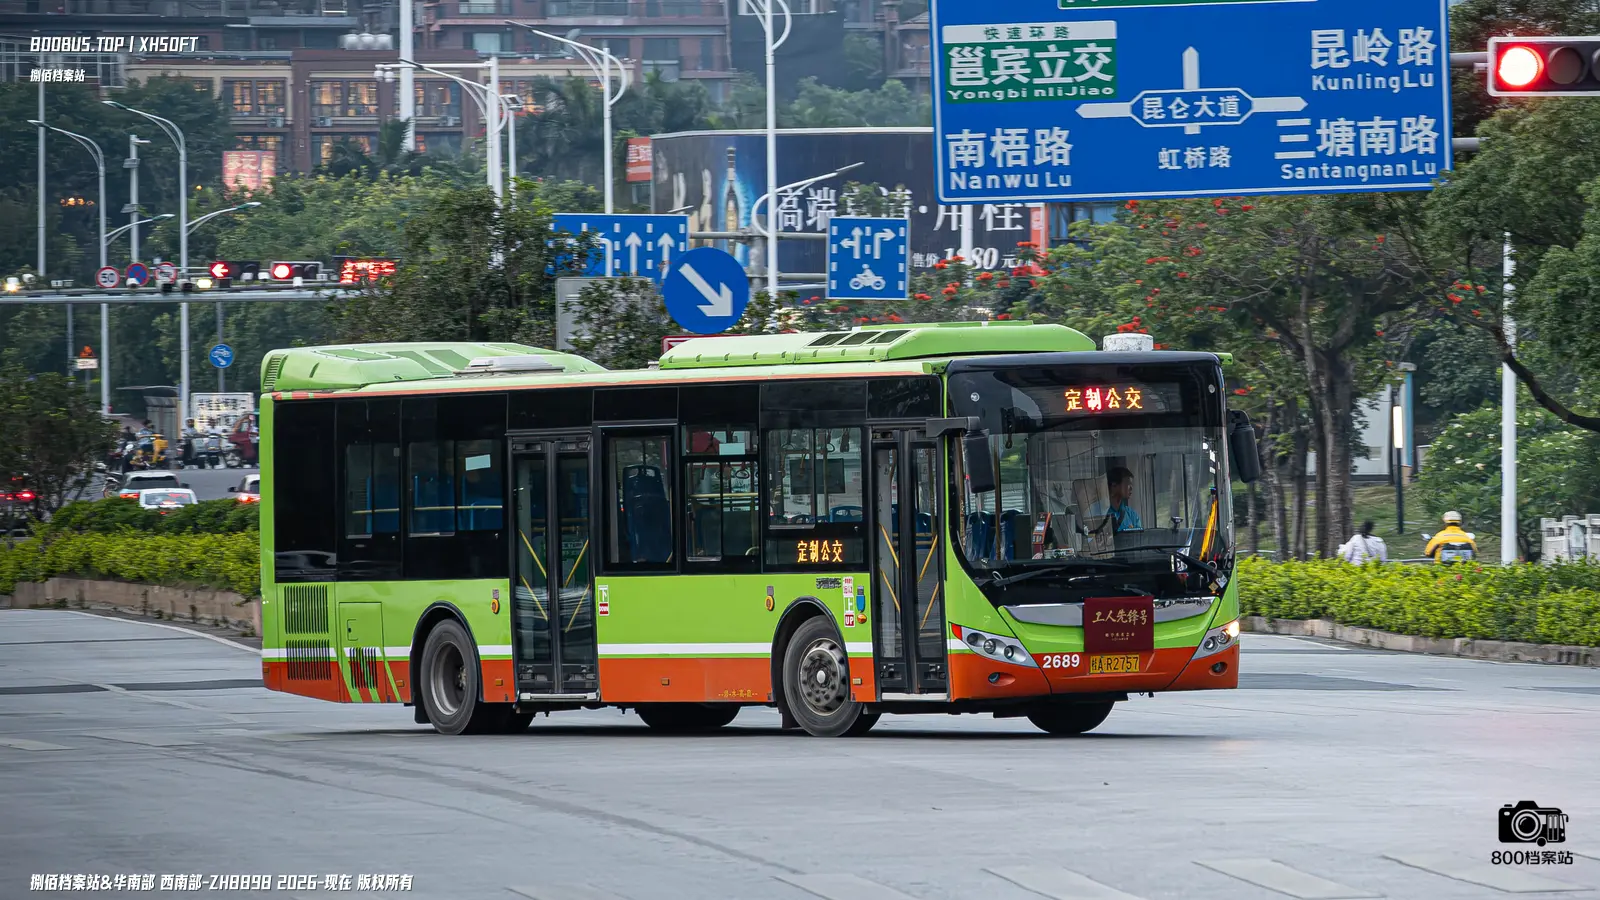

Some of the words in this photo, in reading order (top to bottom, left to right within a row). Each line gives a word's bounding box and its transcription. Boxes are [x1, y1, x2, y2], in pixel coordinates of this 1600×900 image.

[983, 26, 1070, 41] 快速环路
[1310, 26, 1437, 69] 昆岭路
[948, 43, 1114, 86] 邕宾立交
[1142, 95, 1241, 120] 昆仑大道
[945, 127, 1074, 169] 南梧路
[1274, 114, 1439, 160] 三塘南路
[1158, 145, 1233, 170] 虹桥路
[949, 171, 1039, 191] Nanwu
[1044, 171, 1073, 188] Lu
[1280, 162, 1408, 182] Santangnan
[1411, 159, 1437, 176] Lu
[1064, 387, 1143, 411] 定制公交
[797, 539, 843, 563] 定制公交
[599, 587, 608, 602] 下
[845, 597, 854, 614] 上
[846, 616, 854, 625] UP
[1092, 608, 1148, 626] 工人先锋号
[1042, 653, 1081, 669] 2689
